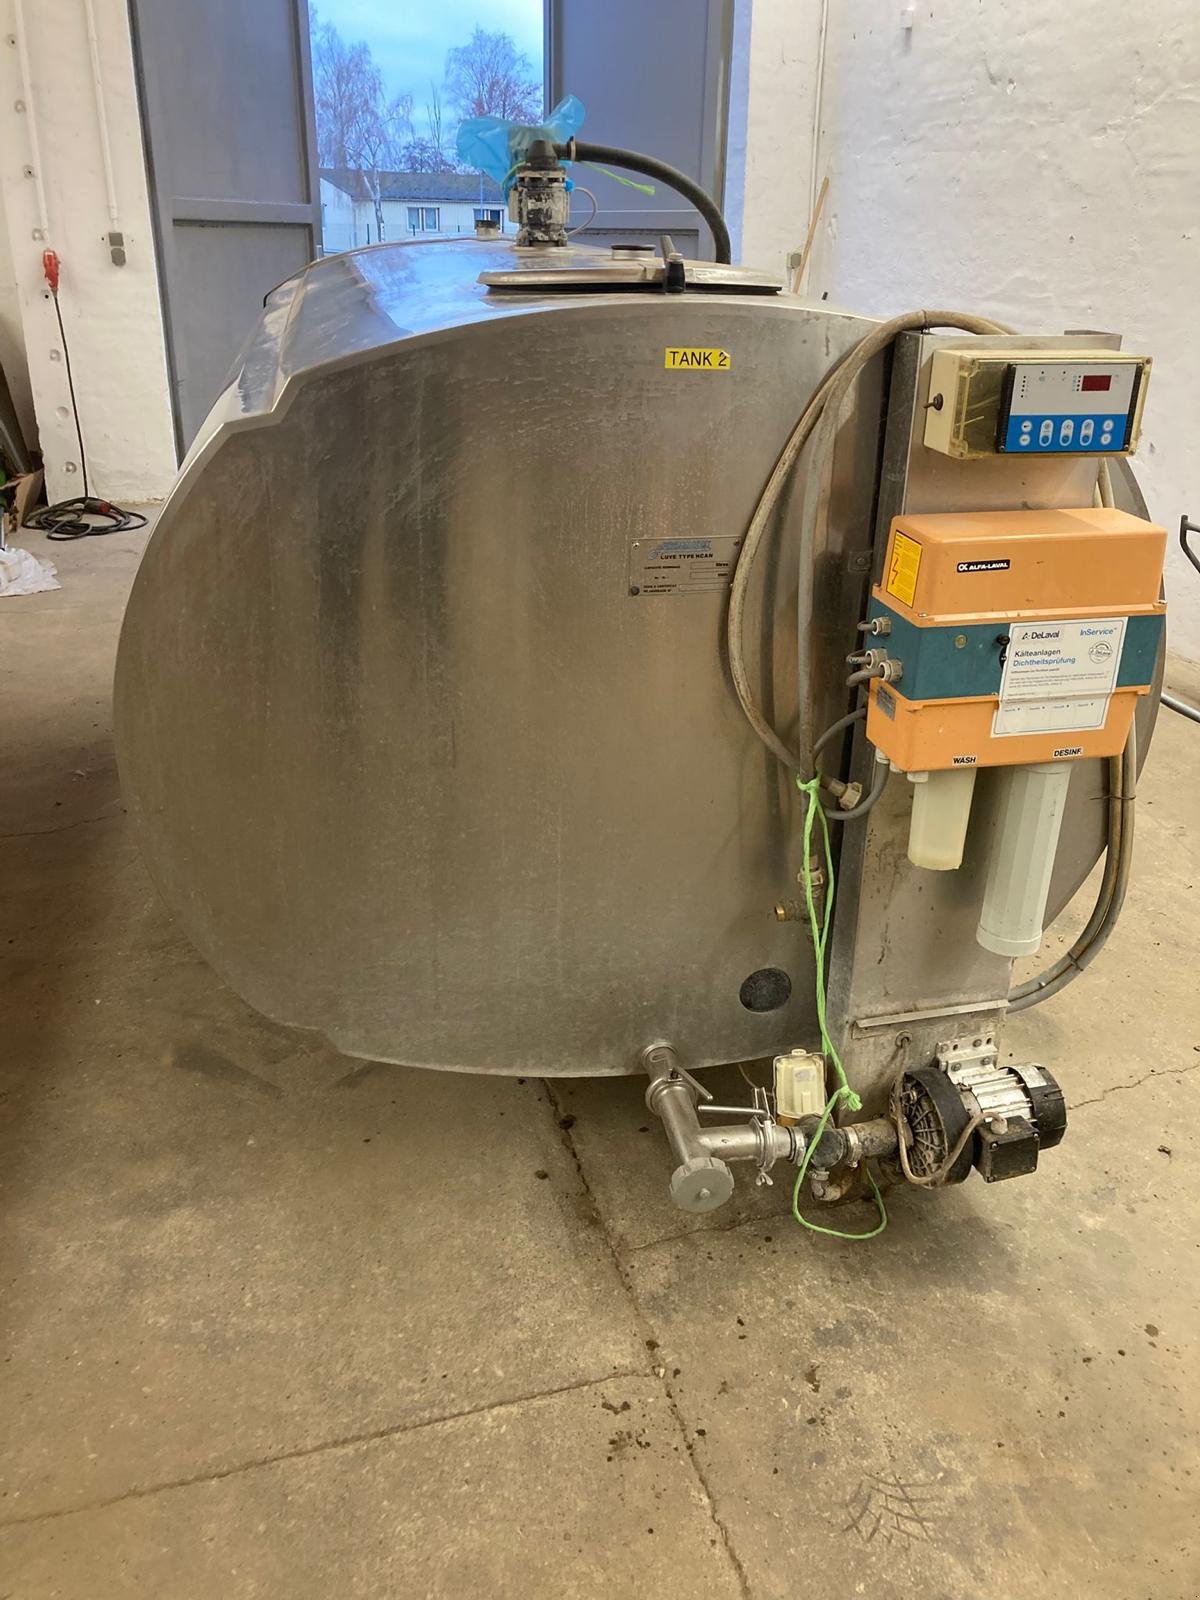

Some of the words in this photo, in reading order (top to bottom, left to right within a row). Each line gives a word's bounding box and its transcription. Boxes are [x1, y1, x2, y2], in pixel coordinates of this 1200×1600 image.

[669, 351, 713, 367] TANK
[718, 351, 727, 367] 2
[968, 561, 1009, 571] ALFA-LAVAL
[1031, 630, 1060, 640] DeLaval
[1080, 628, 1114, 637] InService
[1014, 648, 1061, 658] Kälteanlagen
[1013, 656, 1076, 667] Dichtheitsprüfung
[953, 756, 976, 764] WASH
